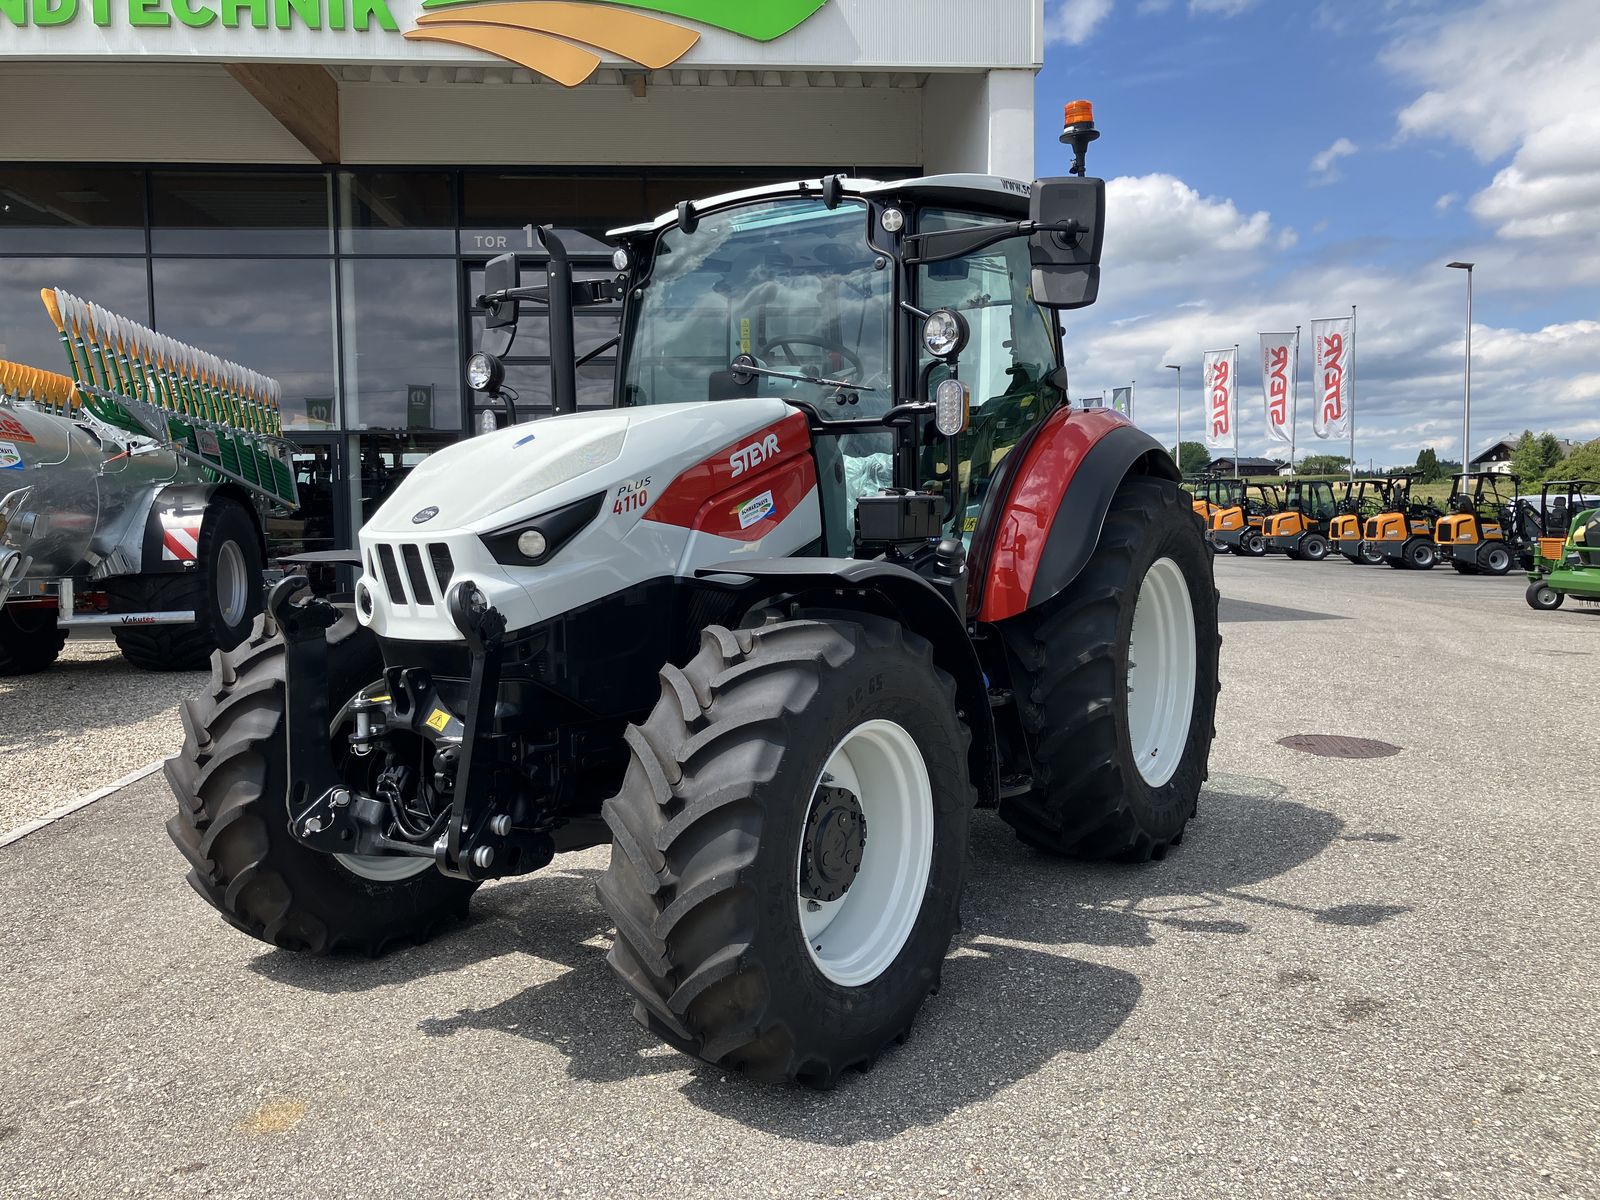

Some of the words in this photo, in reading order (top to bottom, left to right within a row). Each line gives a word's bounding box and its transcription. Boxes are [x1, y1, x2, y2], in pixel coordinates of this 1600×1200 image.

[474, 236, 507, 248] TOR
[729, 433, 781, 478] STEYR
[617, 476, 651, 497] PLUS
[612, 489, 648, 515] 4110
[121, 615, 155, 624] Vakutec
